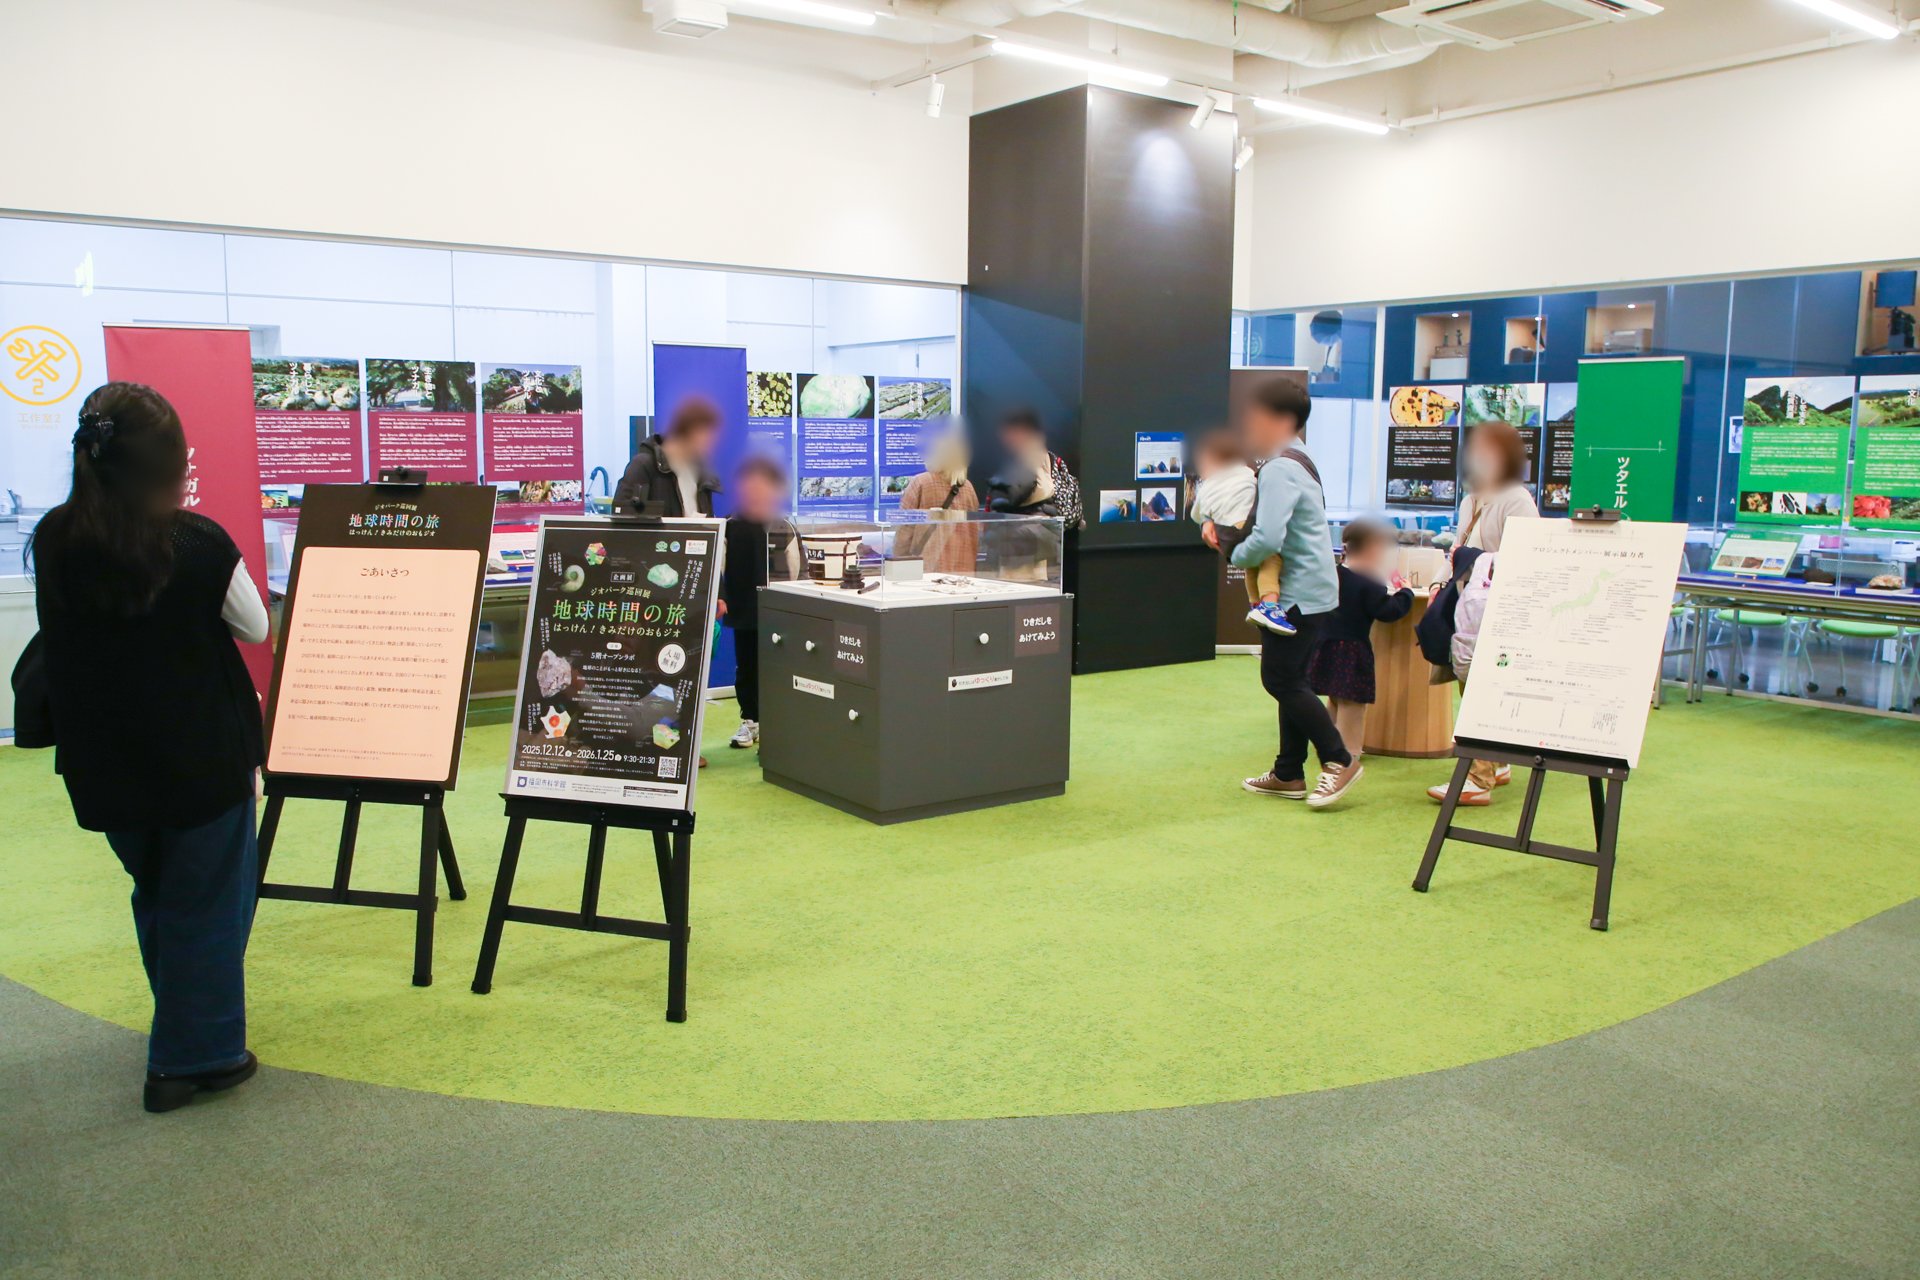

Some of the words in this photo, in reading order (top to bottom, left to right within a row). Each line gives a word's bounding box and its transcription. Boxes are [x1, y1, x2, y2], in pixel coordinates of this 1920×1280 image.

[1613, 456, 1630, 509] ツタエル
[348, 513, 440, 529] 地球時間の旅
[360, 567, 410, 578] ごあいさつ
[590, 586, 652, 599] ジオパーク巡回展
[552, 599, 687, 626] 地球時間の旅
[1022, 616, 1053, 627] ひきだしを
[839, 634, 862, 648] ひきだしを
[1018, 631, 1057, 643] あけてみよう
[590, 652, 636, 662] 5階オープンラボ
[836, 650, 864, 664] あけてみよう
